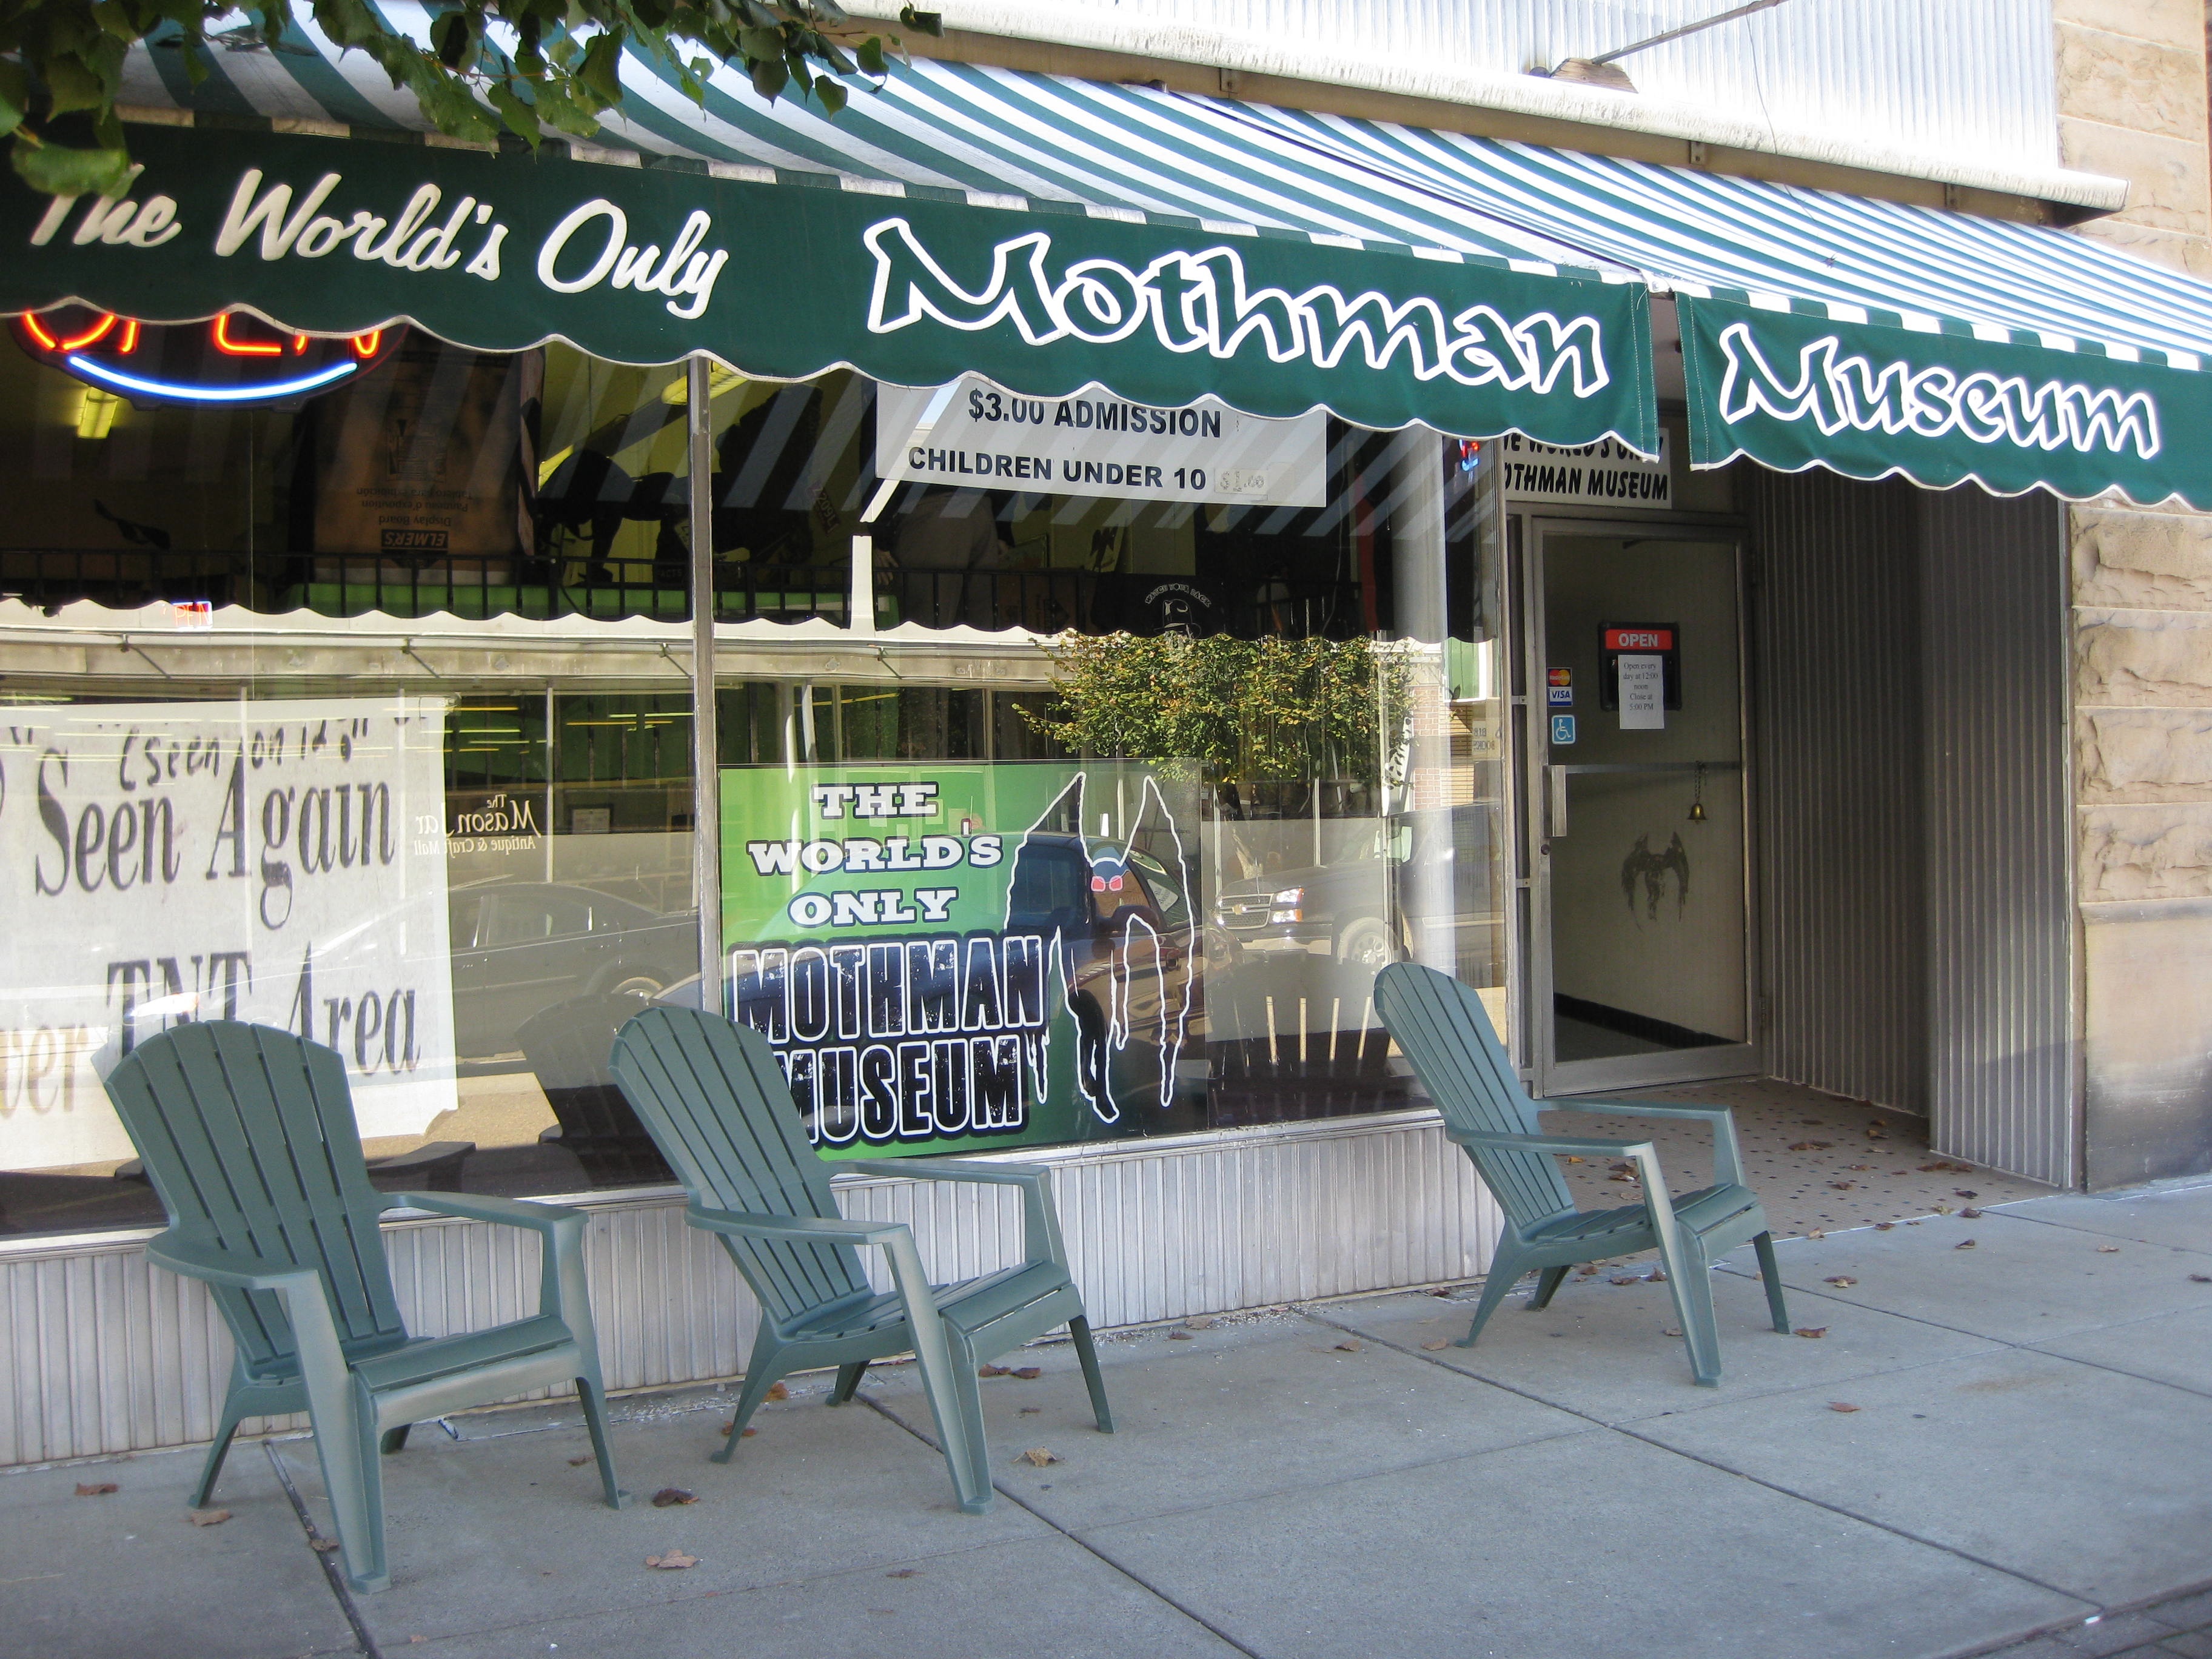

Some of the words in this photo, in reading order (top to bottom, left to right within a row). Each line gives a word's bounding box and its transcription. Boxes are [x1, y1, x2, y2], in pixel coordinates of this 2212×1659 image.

[215, 169, 509, 281] World's
[537, 198, 729, 320] Only
[863, 217, 1610, 398] Mothman
[968, 387, 1045, 424] $3.00
[1053, 399, 1221, 438] ADMISSION
[1719, 323, 2160, 460] Museum
[908, 446, 1051, 480] CHILDREN
[1063, 460, 1163, 488] UNDER
[1173, 468, 1206, 491] 10
[1587, 469, 1668, 501] MUSEUM
[1618, 633, 1658, 647] OPEN
[1552, 690, 1570, 699] VISA
[811, 782, 939, 819] THE
[35, 746, 181, 896] Seen
[204, 736, 395, 931] Again
[746, 819, 1004, 876] WORLD'S
[787, 886, 959, 928] ONLY
[107, 950, 253, 1058] TNT
[288, 940, 421, 1076] Area
[732, 936, 1044, 1044] MOTHMAN
[773, 1034, 1024, 1145] MUSEUM
